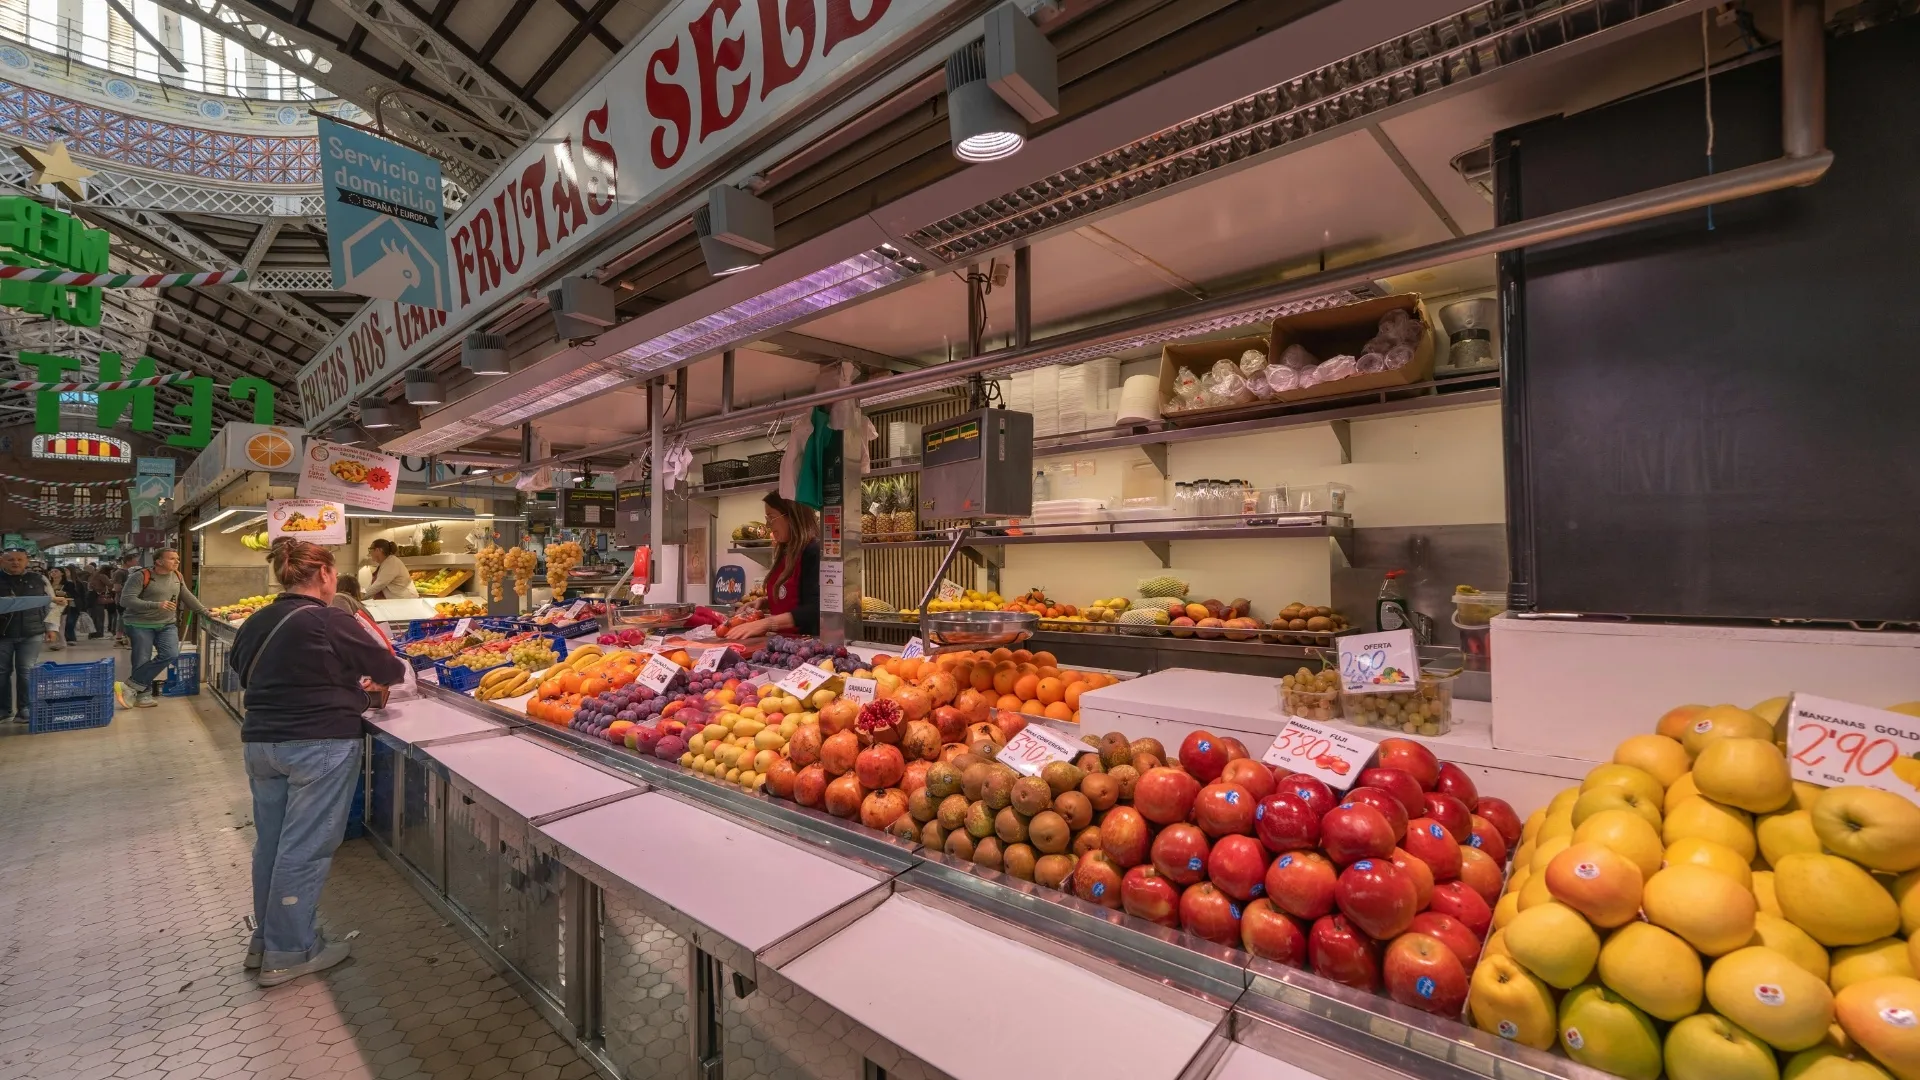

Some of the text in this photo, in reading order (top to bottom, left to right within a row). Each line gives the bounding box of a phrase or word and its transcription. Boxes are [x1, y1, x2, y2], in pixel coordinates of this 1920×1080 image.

[328, 136, 437, 192] Servicio a
[335, 166, 437, 214] domicilio
[451, 98, 618, 309] FRUTAS
[362, 197, 429, 225] ESPAÑA Y EUROPA
[300, 344, 349, 422] FRUTAS
[371, 473, 386, 484] 3€
[1364, 642, 1392, 651] OFERTA
[53, 714, 85, 722] MONZO
[1290, 720, 1348, 743] MANZANAS FUJI
[1798, 710, 1920, 741] MANZANAS GOLD
[1036, 735, 1069, 756] CONFERENCIA
[1272, 728, 1331, 761] 3'80
[1792, 723, 1900, 777] 2'90
[1823, 773, 1845, 784] KILO
